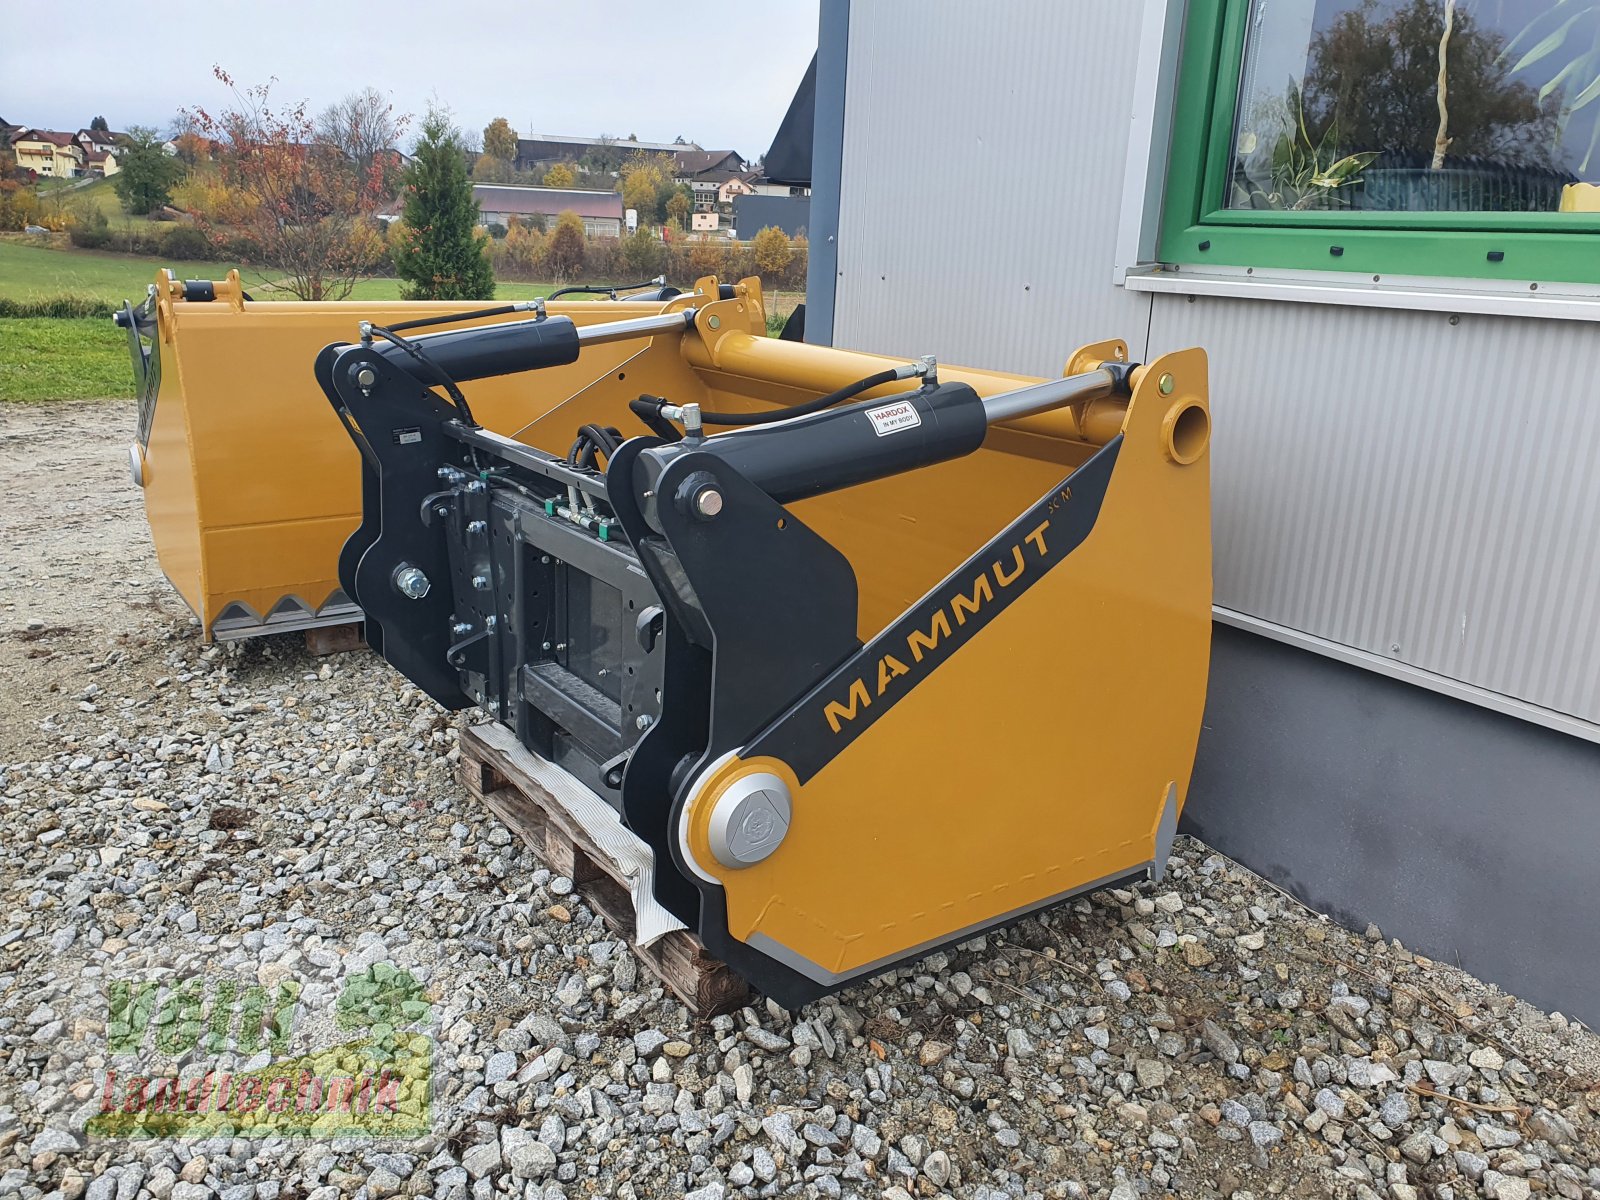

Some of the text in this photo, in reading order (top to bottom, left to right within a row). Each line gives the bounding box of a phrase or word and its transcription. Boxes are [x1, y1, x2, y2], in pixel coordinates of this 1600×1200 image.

[874, 406, 910, 420] HARDOX
[898, 415, 913, 424] BODY
[823, 519, 1050, 734] MAMMUT
